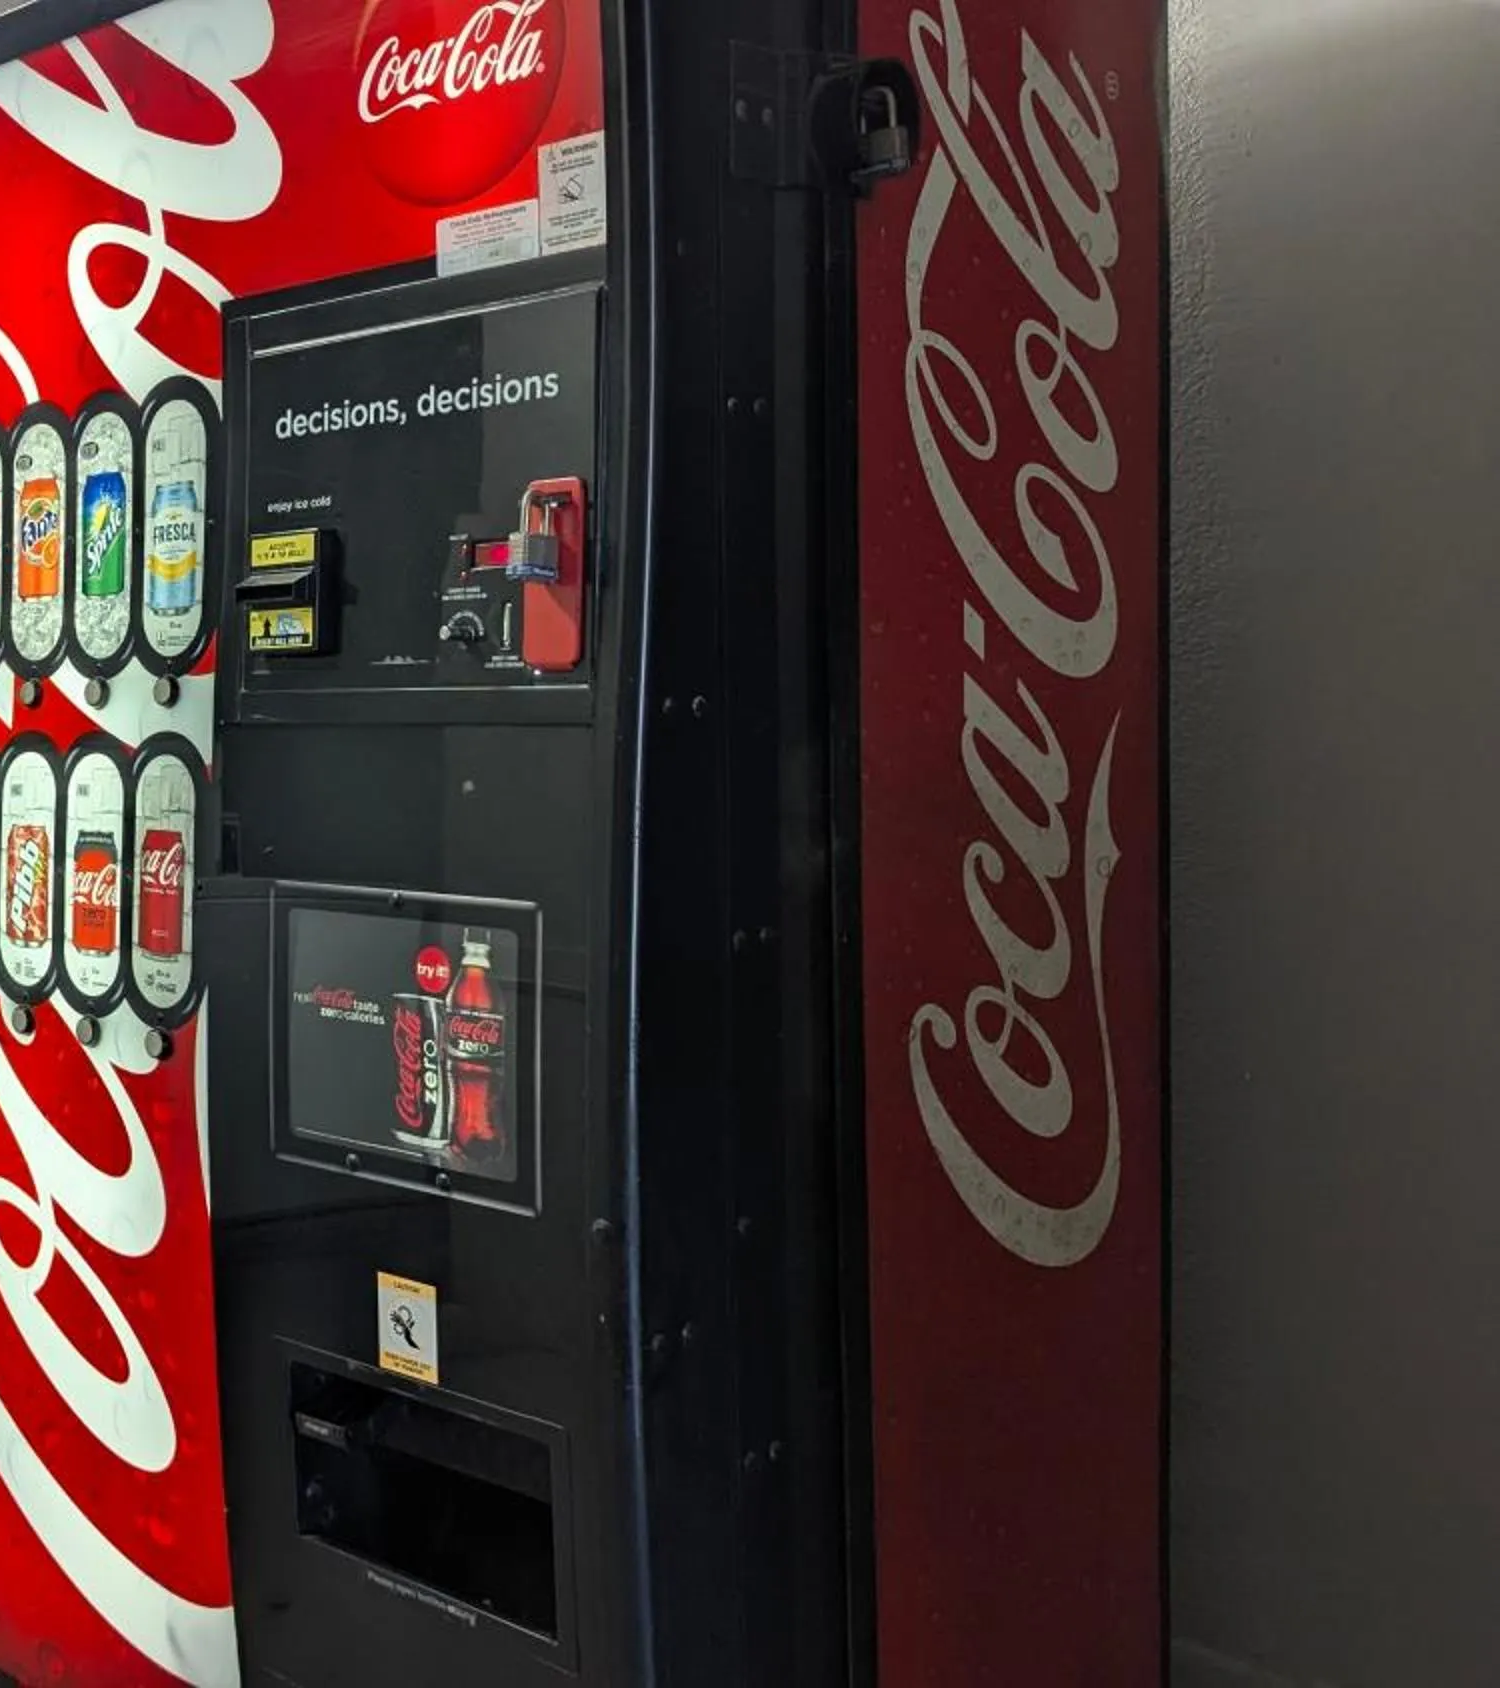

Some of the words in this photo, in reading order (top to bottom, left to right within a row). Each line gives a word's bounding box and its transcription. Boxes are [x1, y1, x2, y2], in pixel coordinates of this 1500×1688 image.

[357, 0, 542, 124] Coca-Cola
[275, 398, 408, 440] decisions,
[416, 371, 560, 418] decisions
[266, 500, 293, 514] enjoy
[294, 498, 309, 510] ice
[309, 494, 332, 508] cold
[86, 501, 124, 576] Sprite
[153, 519, 197, 547] FRESCA
[908, 0, 1120, 1267] Coca-Cola
[417, 963, 436, 980] try
[353, 998, 380, 1013] taste
[450, 1015, 500, 1045] Coca-Cola
[459, 1039, 489, 1055] zero
[394, 1005, 422, 1128] Coca-Cola
[423, 1039, 438, 1104] zero
